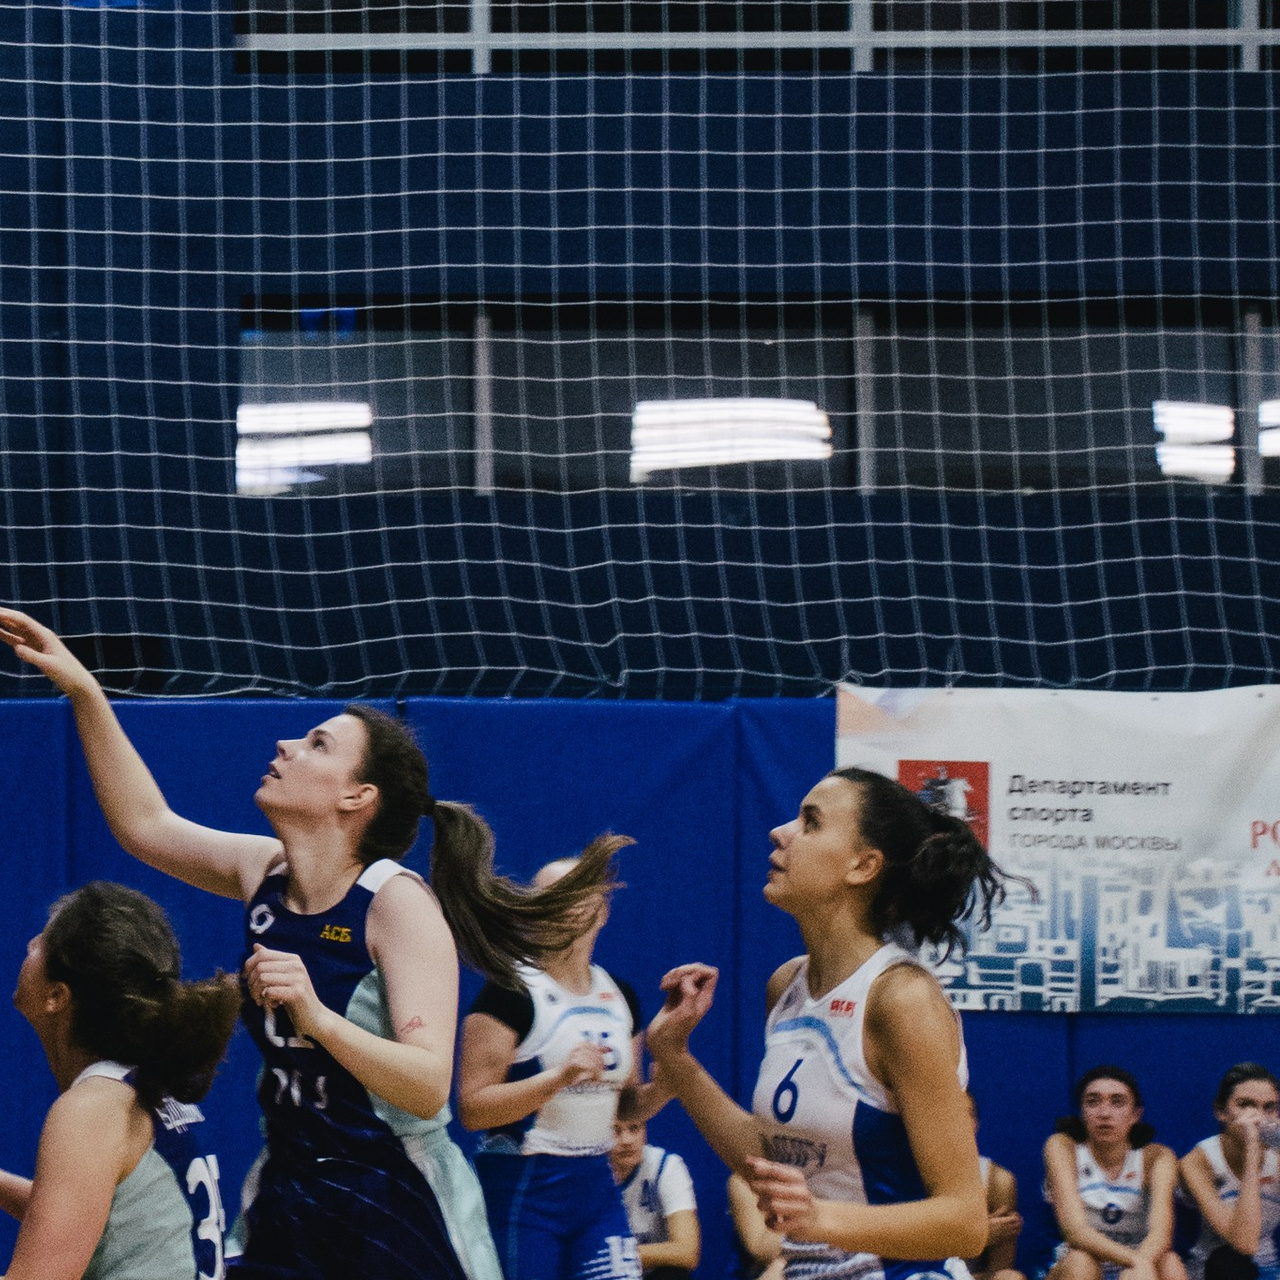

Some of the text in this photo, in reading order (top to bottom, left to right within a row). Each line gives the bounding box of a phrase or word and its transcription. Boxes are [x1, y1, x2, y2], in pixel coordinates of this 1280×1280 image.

[1006, 774, 1172, 799] Департамент
[1007, 806, 1094, 827] спорта
[1008, 833, 1182, 852] ГОРОДА МОСКВЫ
[772, 1058, 804, 1124] 6
